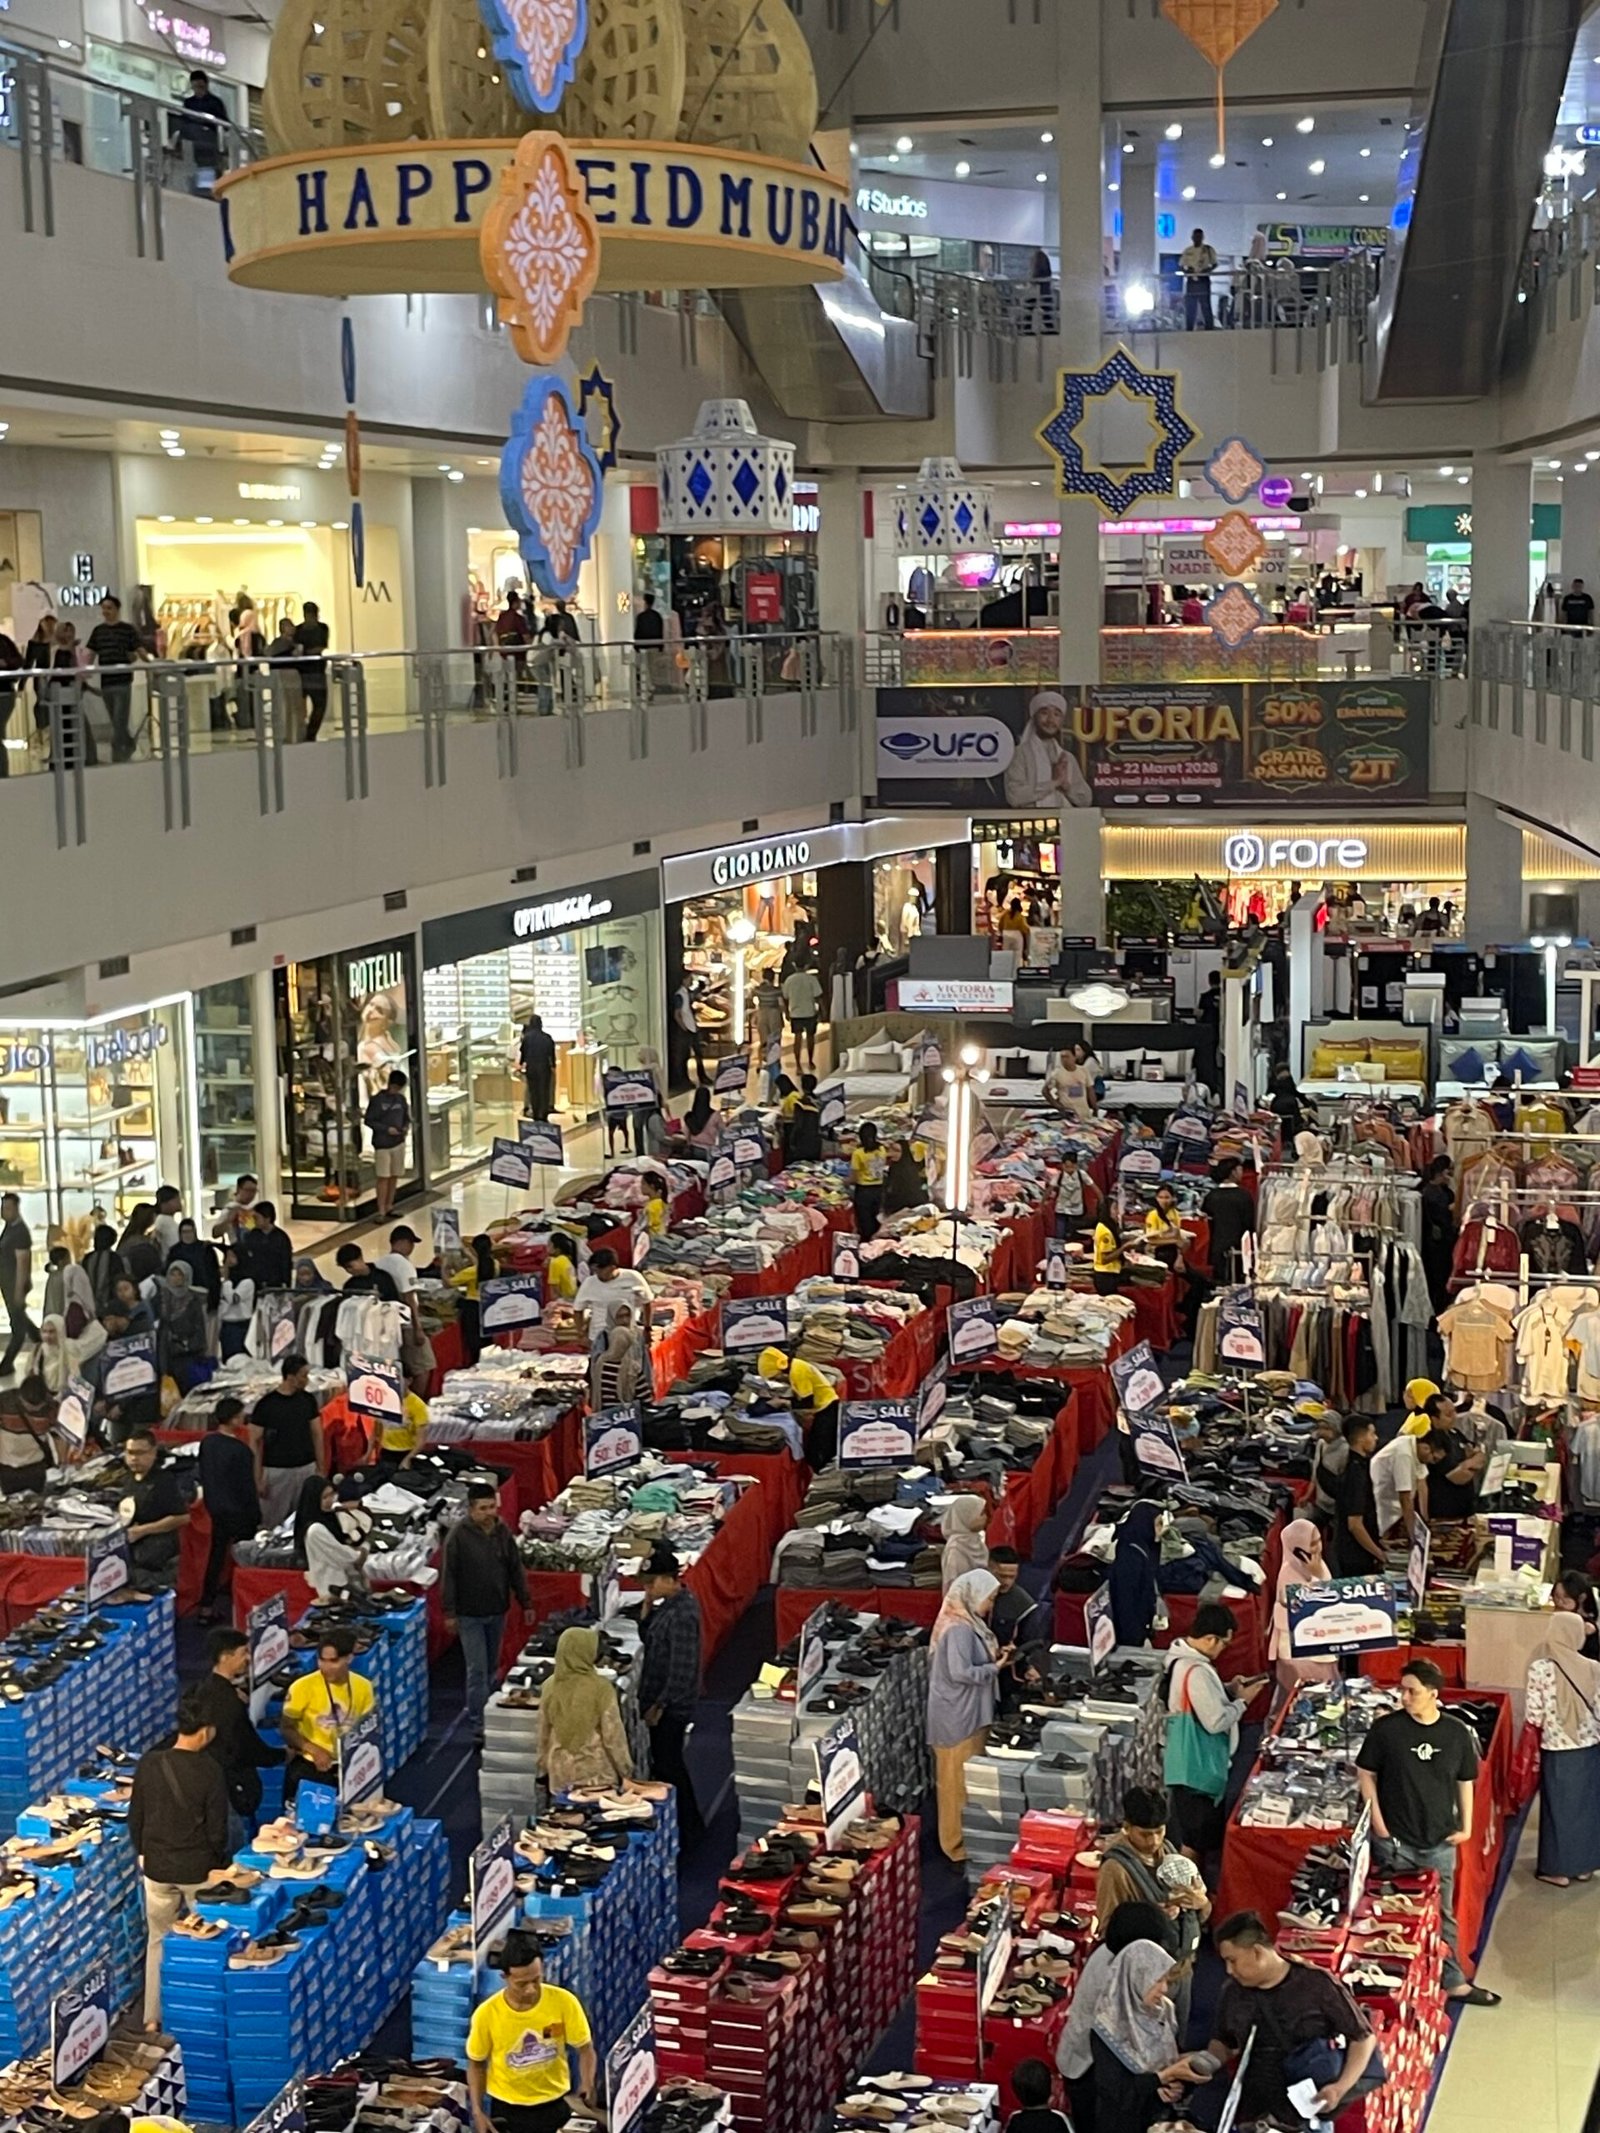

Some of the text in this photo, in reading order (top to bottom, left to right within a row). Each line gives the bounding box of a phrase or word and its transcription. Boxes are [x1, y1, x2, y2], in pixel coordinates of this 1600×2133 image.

[297, 160, 491, 235] HAPP
[576, 160, 703, 228] EID
[870, 189, 928, 218] Studios
[1353, 228, 1388, 246] CORNE
[1169, 549, 1212, 560] CRAFT
[1169, 563, 1211, 574] MADE
[1252, 560, 1286, 574] NJOY
[1264, 701, 1323, 726] 50%
[1336, 706, 1407, 719] Elektronik
[1073, 705, 1241, 743] UFORIA
[933, 732, 999, 757] UFO
[1259, 750, 1322, 766] GRATIS
[1124, 763, 1140, 774] 22
[1142, 762, 1183, 774] Maret
[1254, 764, 1328, 780] PASANG
[1143, 776, 1180, 786] Atrium
[713, 842, 810, 886] GIORDANO
[936, 984, 996, 993] VICTORIA
[627, 1071, 650, 1081] SALE
[1144, 1140, 1164, 1150] SALE
[511, 1276, 537, 1292] SALE
[755, 1300, 782, 1313] SALE
[972, 1300, 993, 1314] SALE
[1239, 1314, 1260, 1328] SALE
[128, 1337, 151, 1353] SALE
[1131, 1347, 1151, 1367] SALE
[373, 1362, 398, 1378] SALE
[612, 1407, 636, 1425] SALE
[879, 1404, 912, 1419] SALE
[1342, 1581, 1387, 1600] SALE
[837, 1718, 855, 1745] SALE
[492, 1823, 512, 1855] SALE
[84, 1968, 107, 2002] SALE
[632, 2010, 652, 2049] SALE
[273, 2086, 300, 2130] SALE
